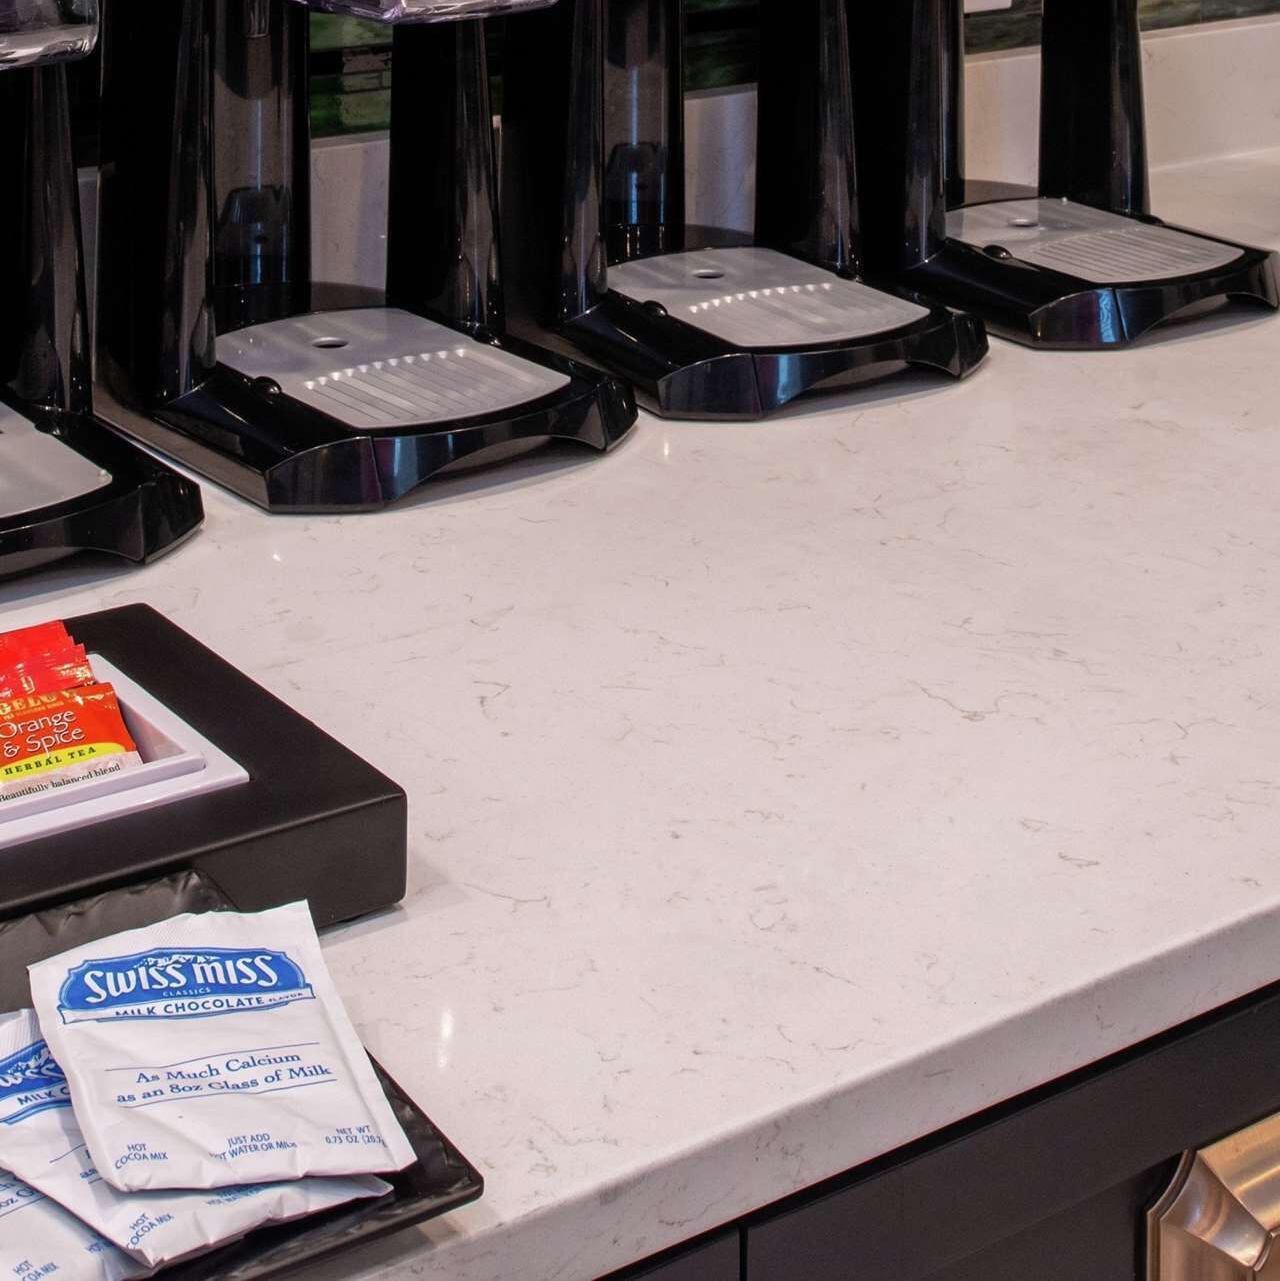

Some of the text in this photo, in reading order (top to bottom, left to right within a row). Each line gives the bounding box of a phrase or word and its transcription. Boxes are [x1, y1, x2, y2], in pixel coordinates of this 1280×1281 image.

[3, 727, 85, 758] & Spice
[4, 747, 97, 776] HERBAL TEA
[51, 772, 93, 789] balanced
[94, 763, 121, 777] blend
[162, 987, 211, 997] CLASSICS
[163, 996, 265, 1015] CHOCOLATE
[136, 1052, 302, 1084] As Much Calcium
[117, 1064, 332, 1104] as an 8oz Glass of Milk
[17, 1090, 58, 1107] MILK
[335, 1125, 371, 1136] NET WT
[127, 1143, 147, 1153] HOT
[227, 1133, 271, 1148] JUST ADD
[325, 1135, 360, 1145] 0.73 OZ
[228, 1143, 260, 1160] WATER
[260, 1143, 274, 1153] OR
[114, 1152, 169, 1170] COCOA MIX
[129, 1213, 150, 1231] HOT
